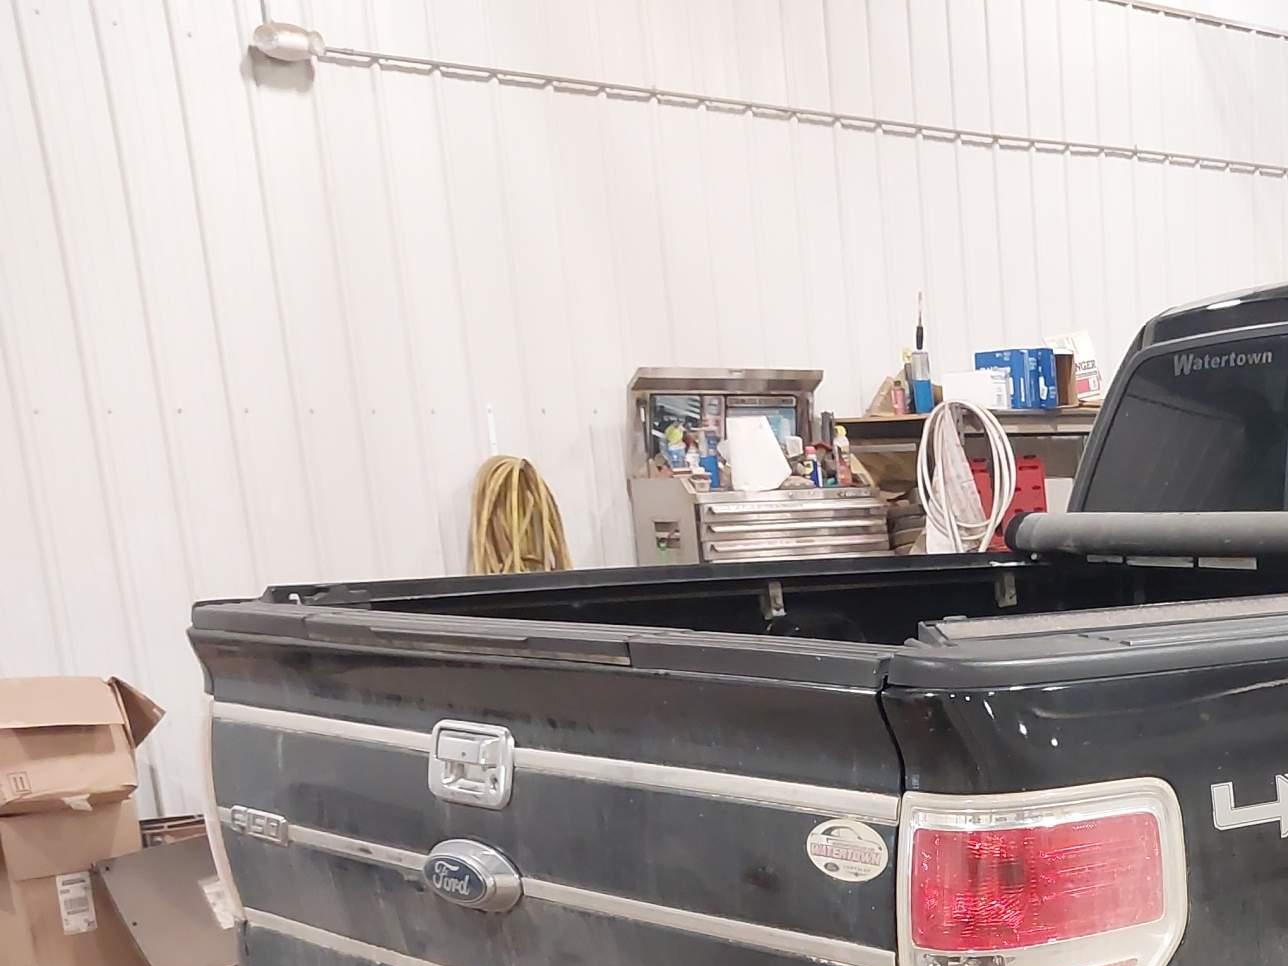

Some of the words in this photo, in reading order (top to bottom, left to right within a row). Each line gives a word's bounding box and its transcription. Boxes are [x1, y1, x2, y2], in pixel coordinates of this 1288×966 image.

[1172, 351, 1273, 377] Watertown
[810, 841, 881, 866] WATERTOWN
[432, 860, 471, 896] Ford
